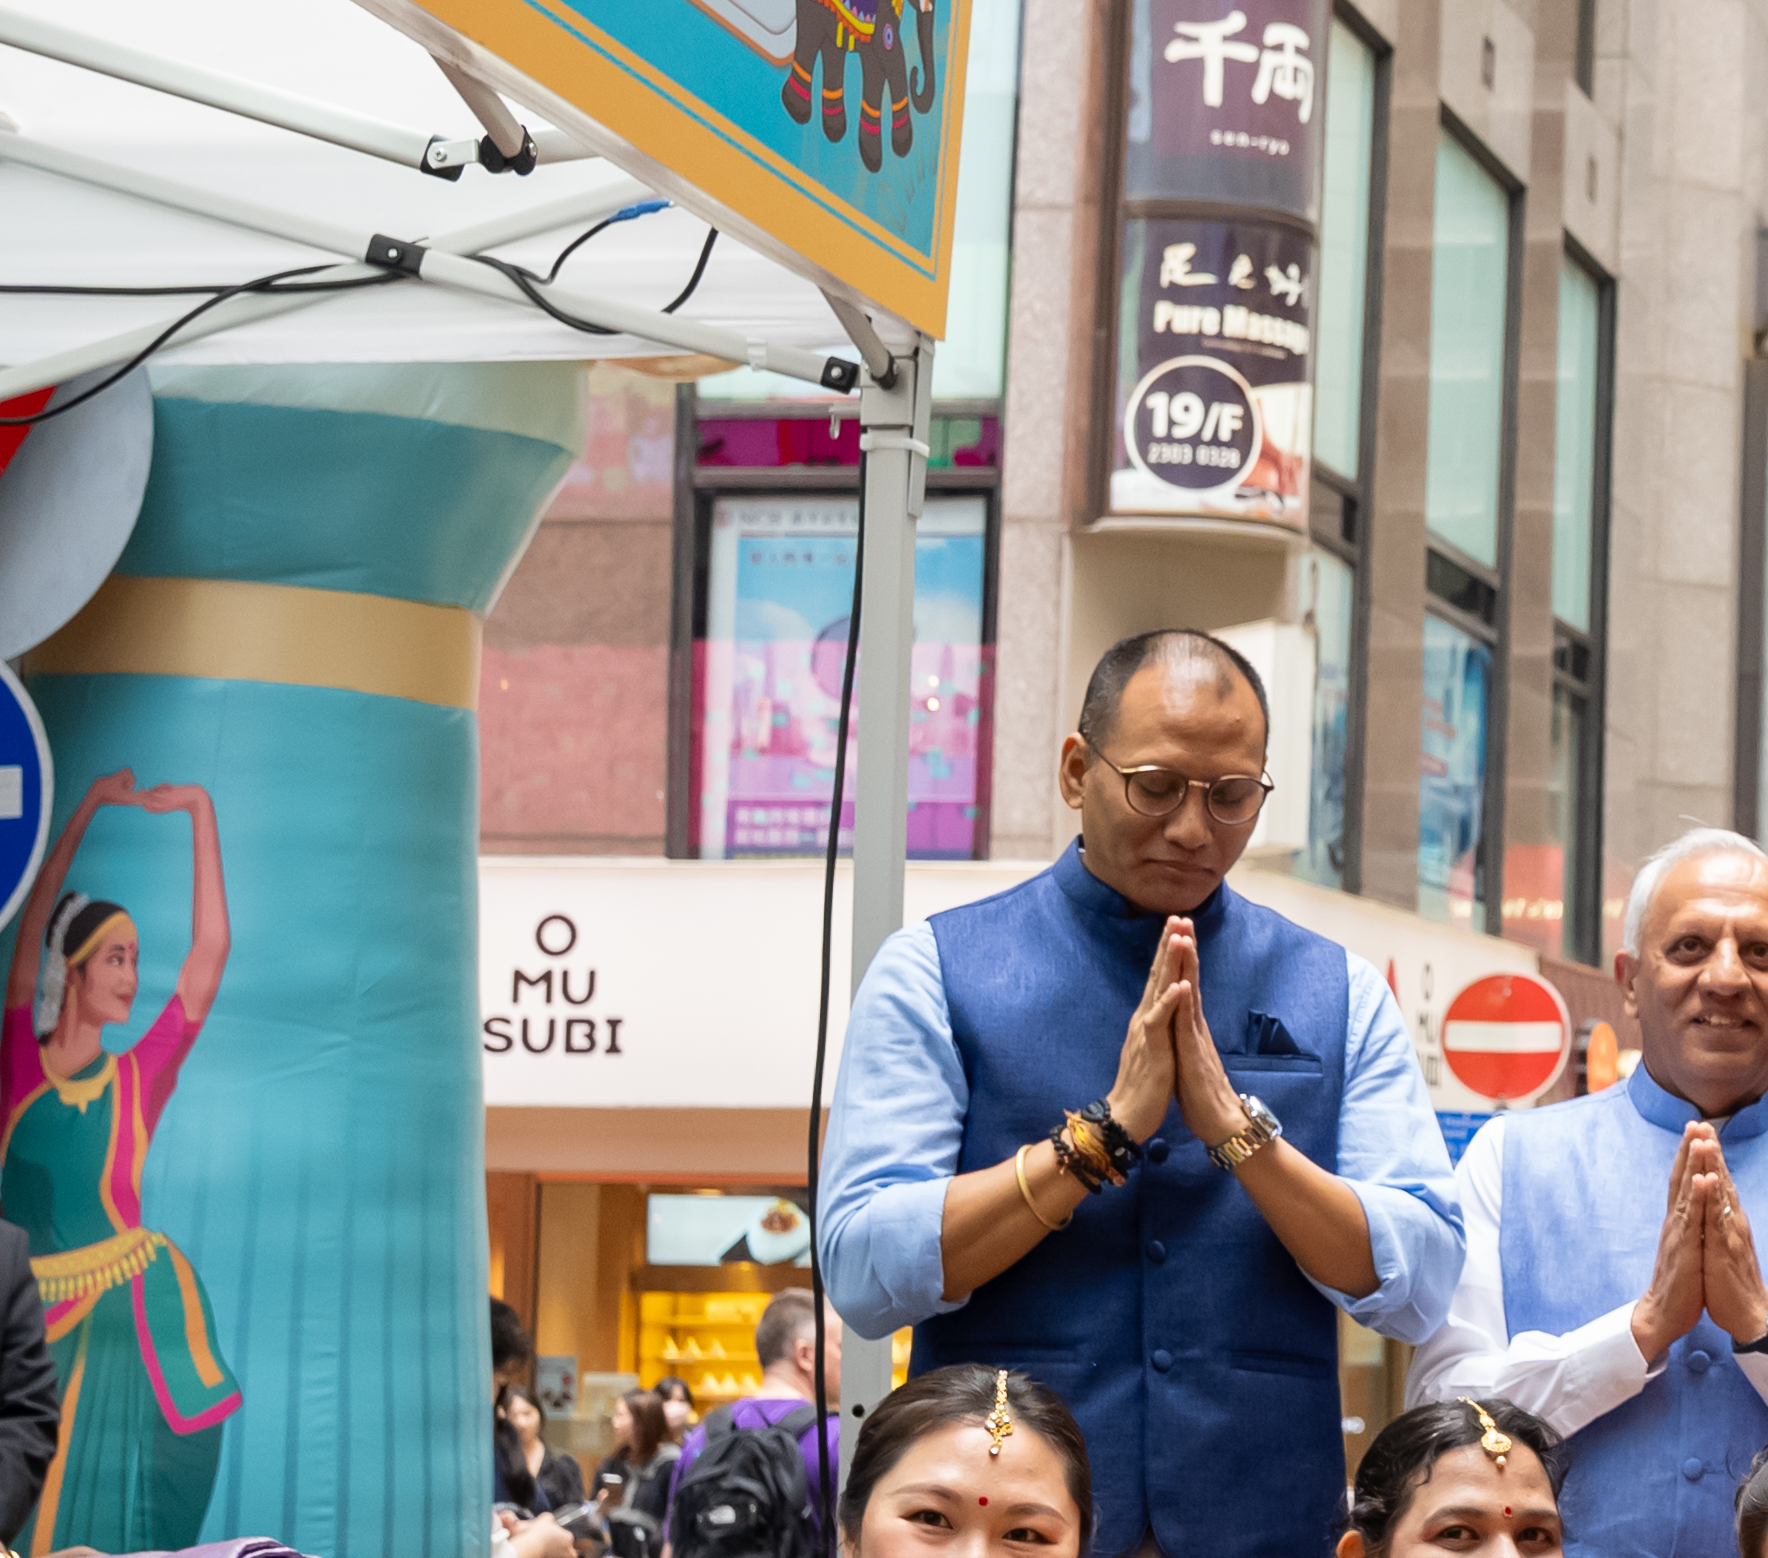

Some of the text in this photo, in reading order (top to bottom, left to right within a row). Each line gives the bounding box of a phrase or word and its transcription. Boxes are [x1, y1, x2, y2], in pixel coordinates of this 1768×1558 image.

[1144, 390, 1245, 443] 19/F
[535, 914, 577, 956] O
[512, 970, 596, 1005] MU
[482, 1018, 623, 1055] SUBI
